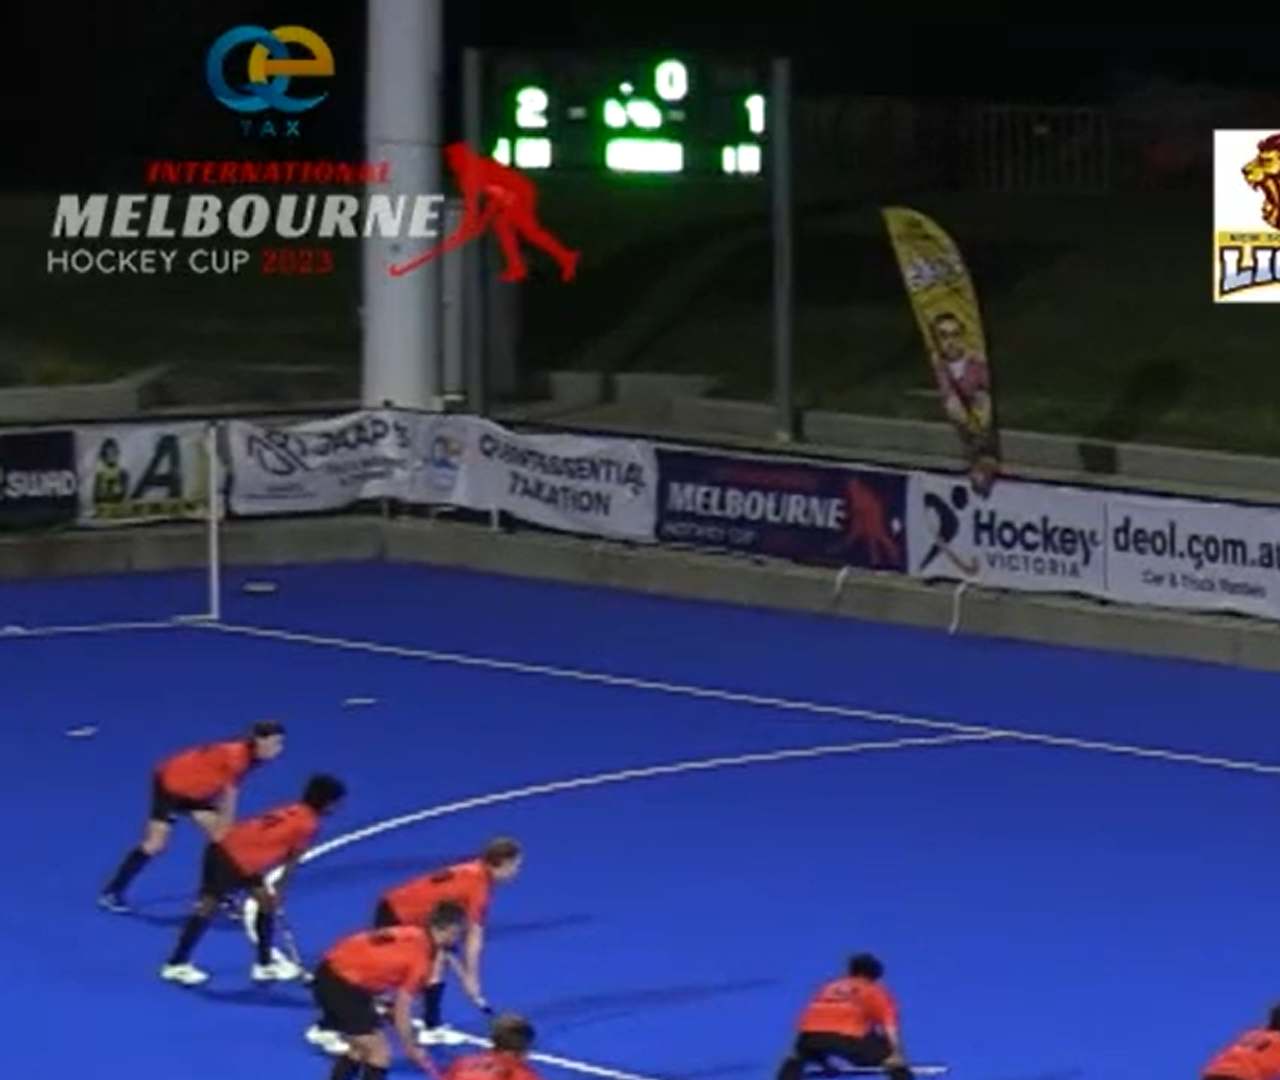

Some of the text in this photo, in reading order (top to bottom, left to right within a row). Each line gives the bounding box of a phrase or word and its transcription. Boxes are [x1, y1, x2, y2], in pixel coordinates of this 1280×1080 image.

[516, 87, 548, 128] 2
[667, 481, 849, 529] MELBOURNE
[972, 508, 1098, 566] Hockey
[986, 552, 1081, 578] VICTORIA
